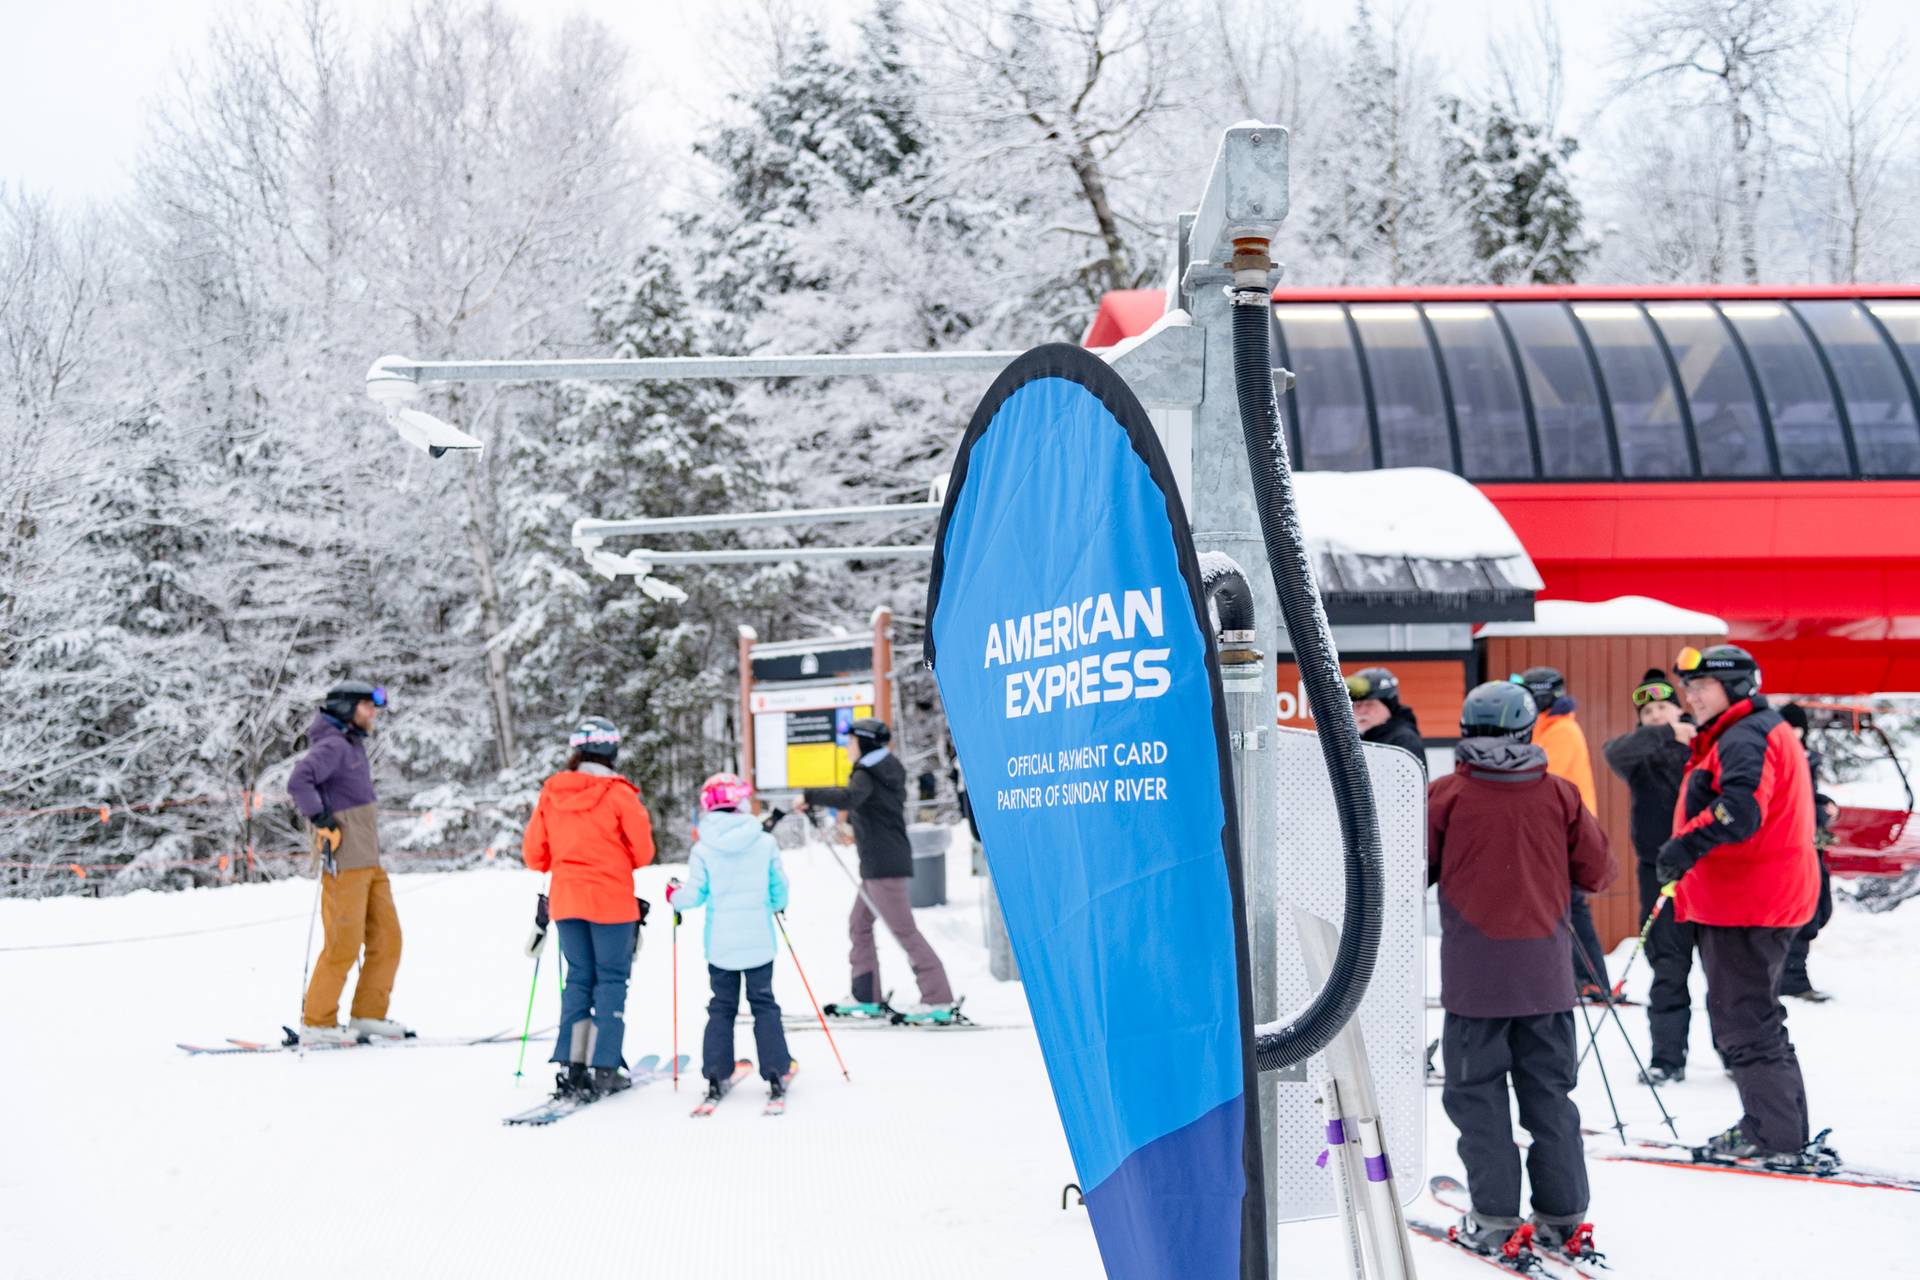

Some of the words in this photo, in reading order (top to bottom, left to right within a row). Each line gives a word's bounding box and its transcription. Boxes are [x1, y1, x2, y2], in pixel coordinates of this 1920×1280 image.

[983, 587, 1165, 669] AMERICAN
[1005, 648, 1172, 719] EXPRESS
[1007, 753, 1055, 778] OFFICIAL
[1058, 745, 1109, 772] PAYMENT
[1113, 741, 1168, 767] CARD
[997, 789, 1043, 810] PARTNER
[1045, 784, 1060, 807] OF
[1062, 780, 1110, 806] SUNDAY
[1114, 777, 1168, 801] RIVER
